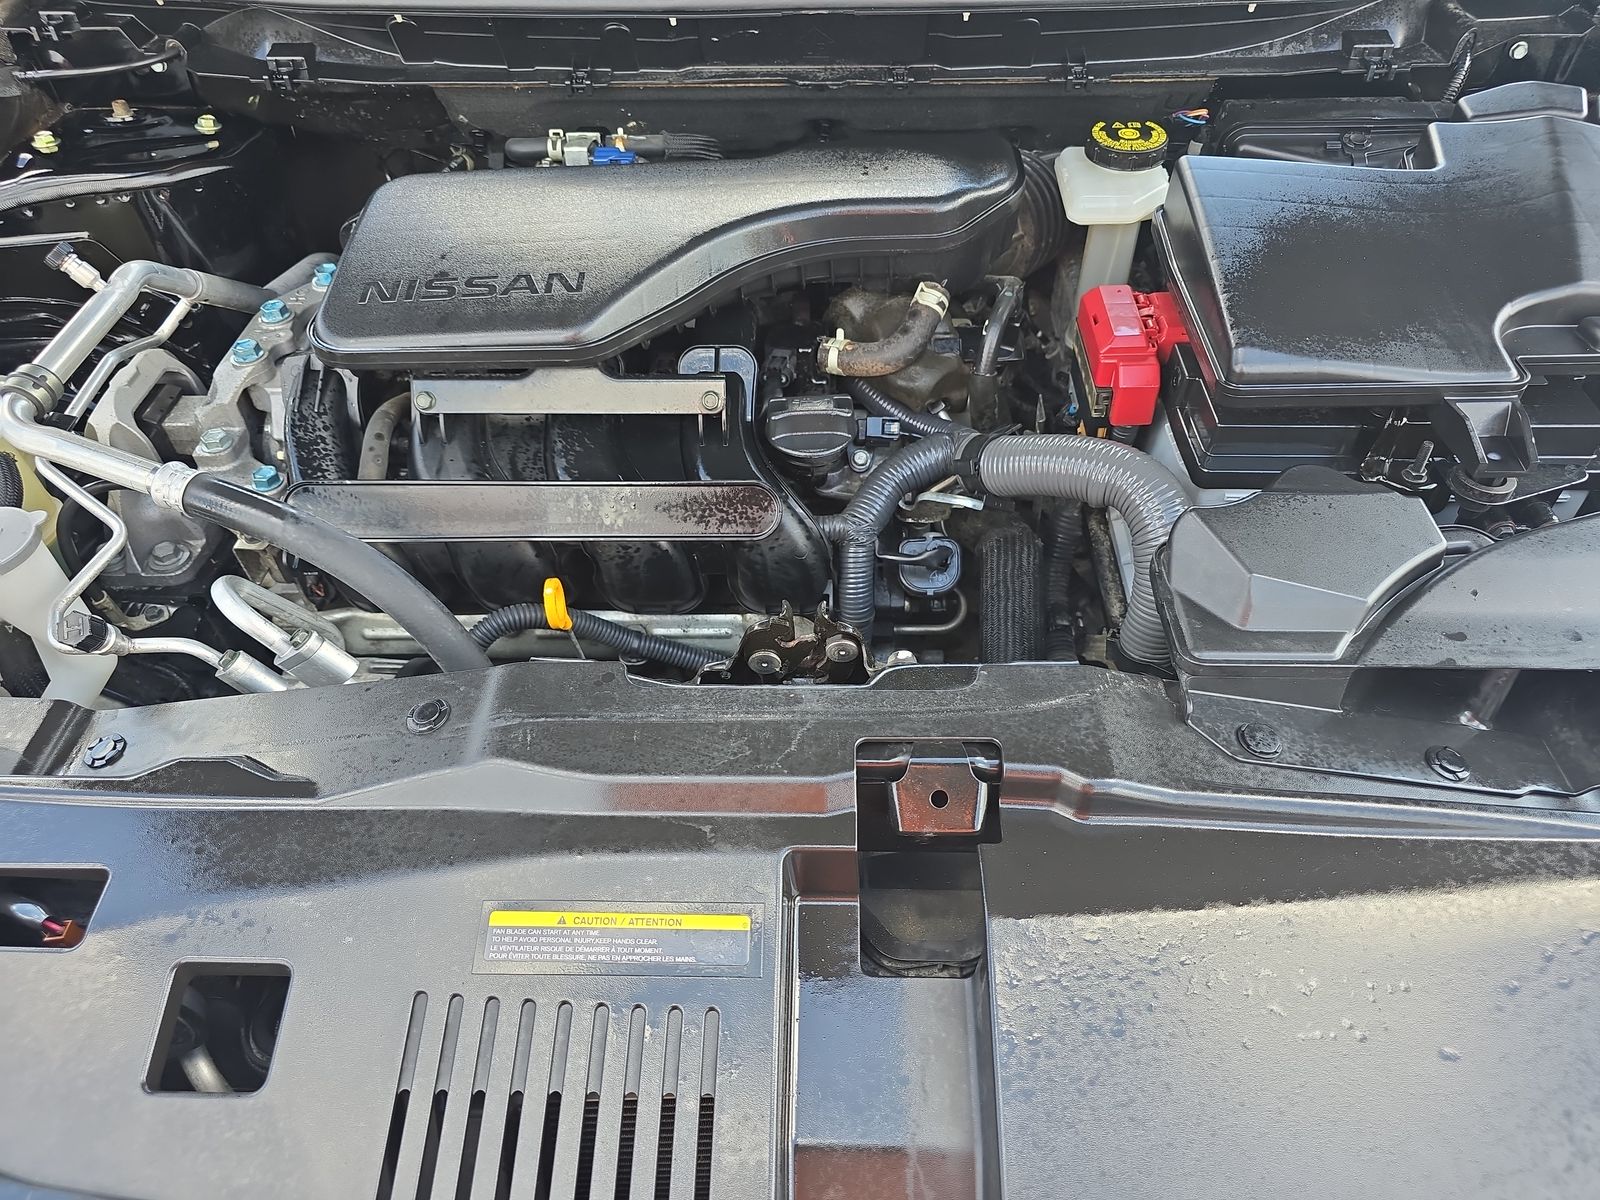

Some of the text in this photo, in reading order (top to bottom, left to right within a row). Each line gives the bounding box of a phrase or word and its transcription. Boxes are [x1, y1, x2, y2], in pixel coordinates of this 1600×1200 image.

[357, 271, 586, 305] NISSAN
[573, 916, 683, 927] CAUTION / ATTENTION
